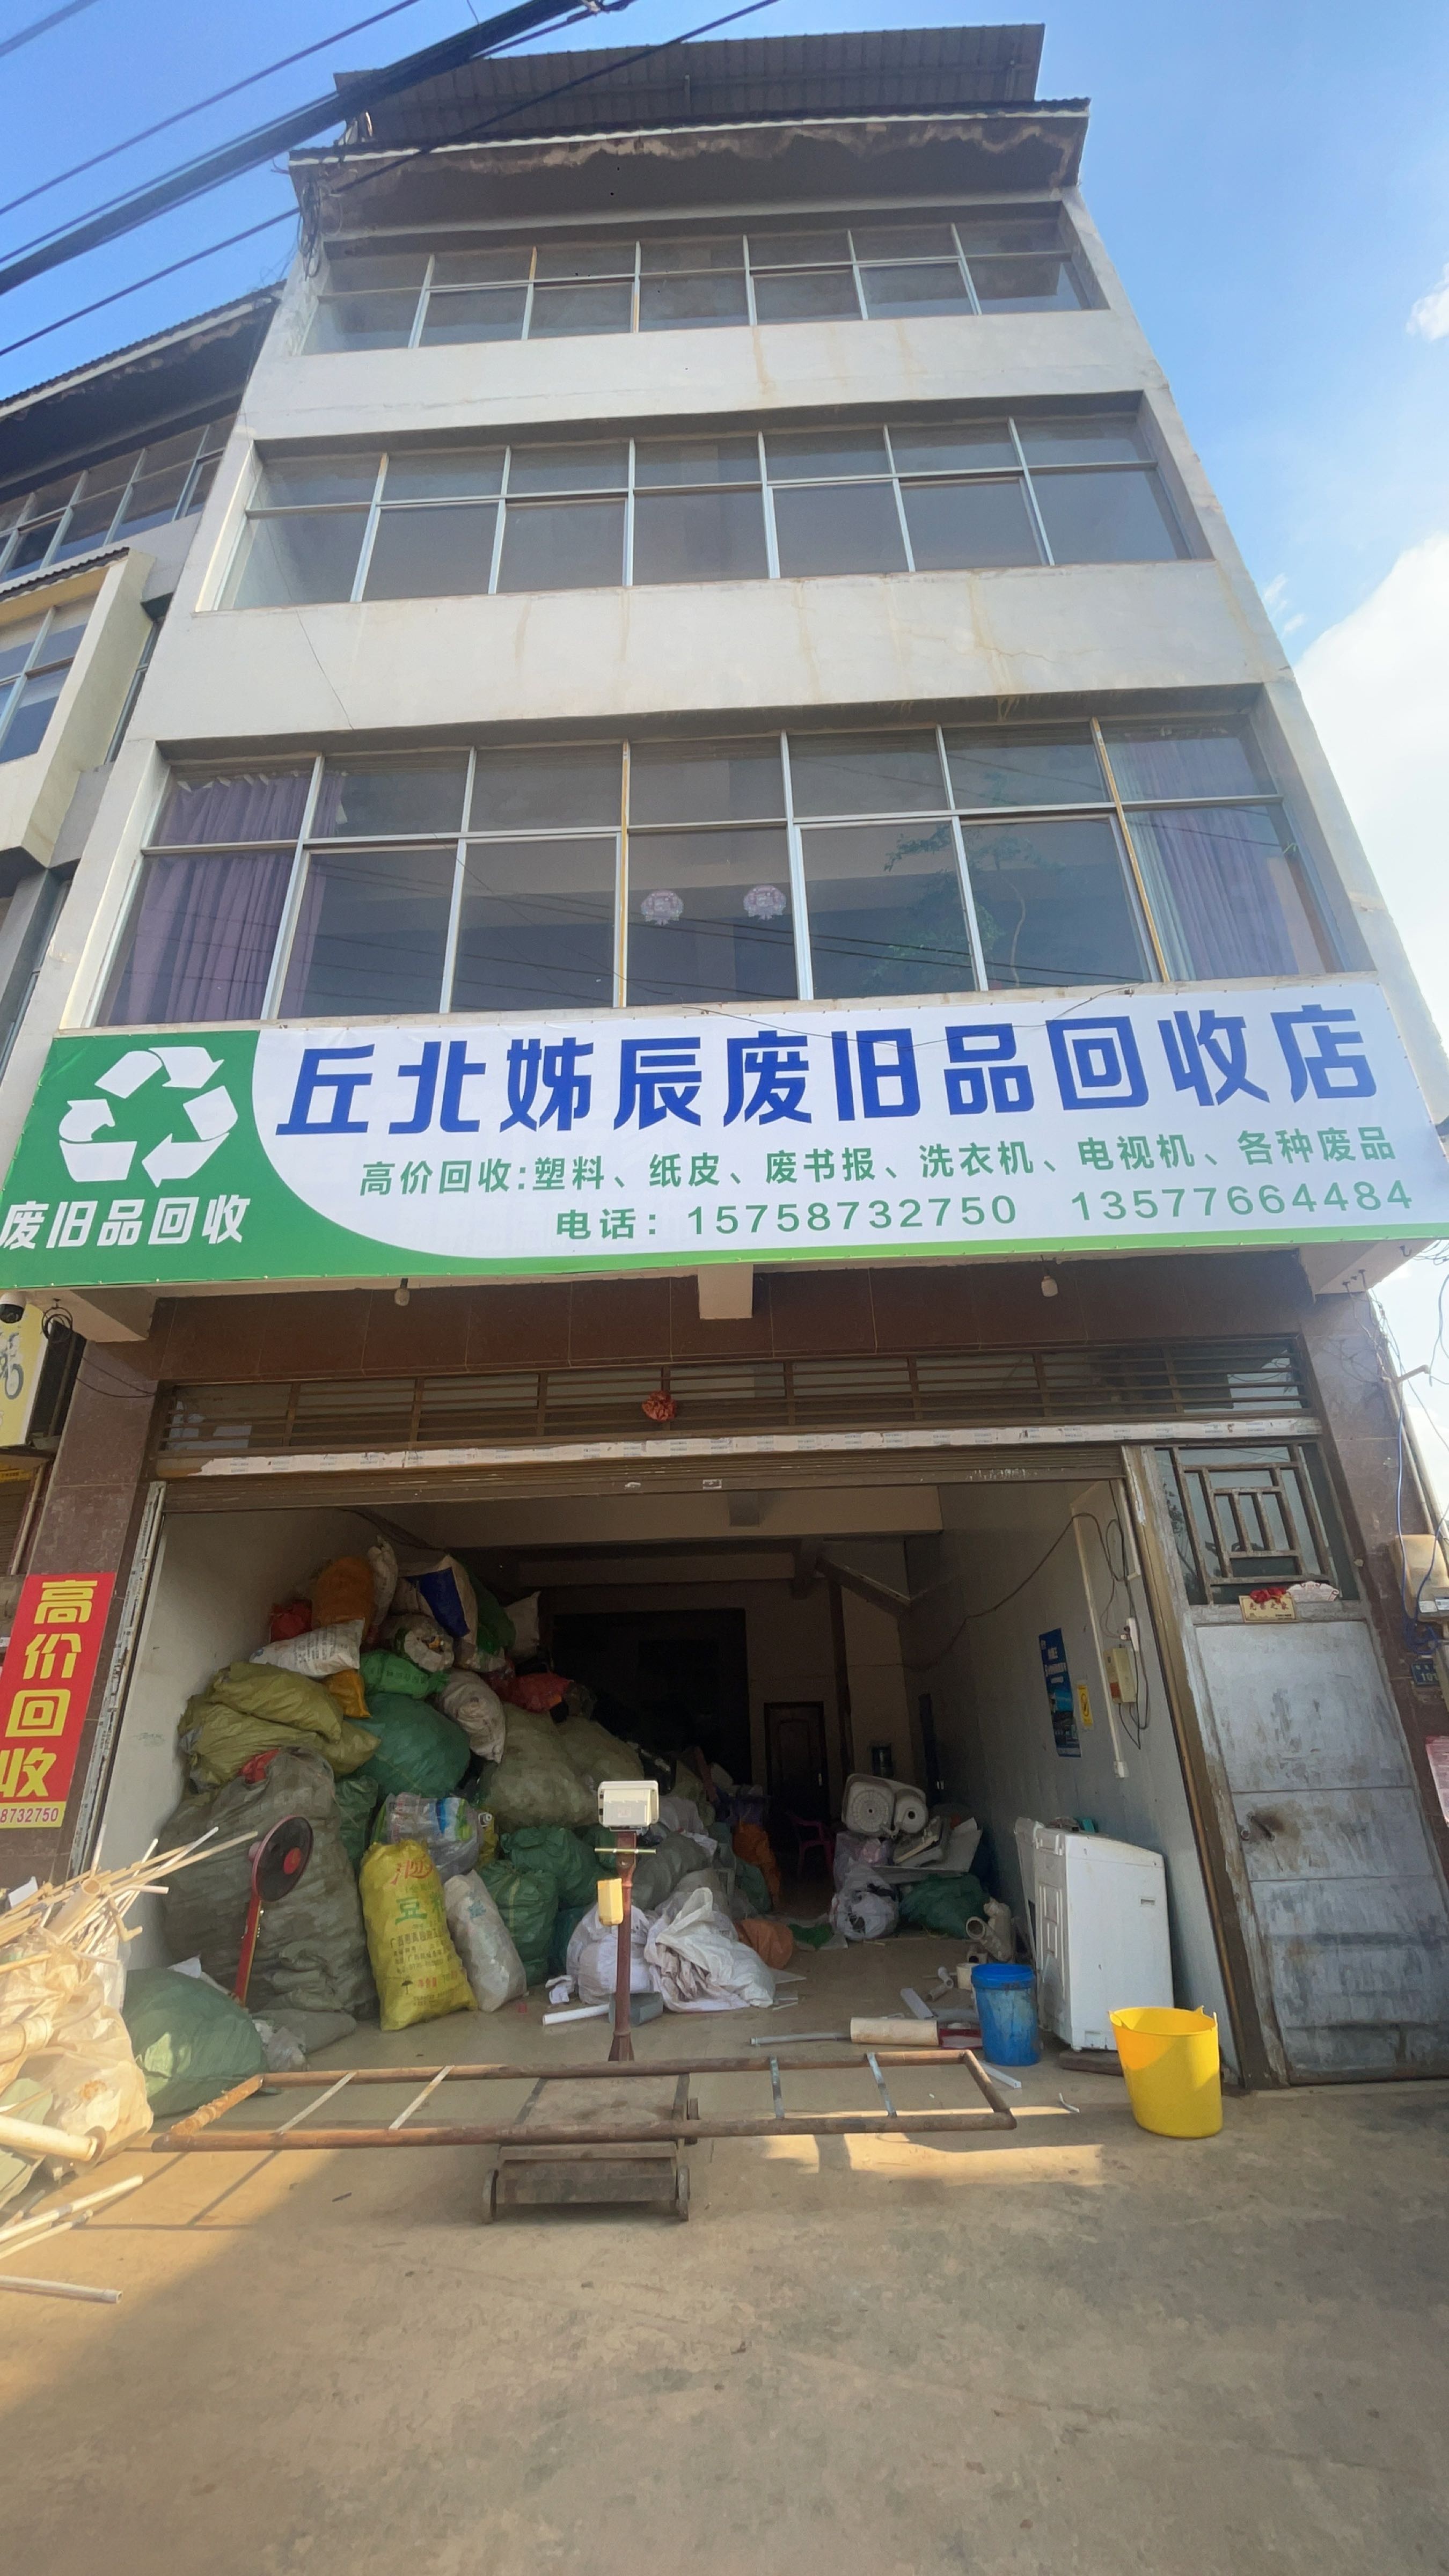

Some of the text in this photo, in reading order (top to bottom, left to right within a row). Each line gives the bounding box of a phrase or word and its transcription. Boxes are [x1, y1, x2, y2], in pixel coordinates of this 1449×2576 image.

[276, 1005, 1377, 1136] 丘北姊辰废旧品回收店
[0, 1193, 251, 1250] 废旧品回收
[1072, 1180, 1413, 1221] 13577664484
[0, 1579, 98, 1798] 高价回收
[0, 1807, 59, 1823] 8732750
